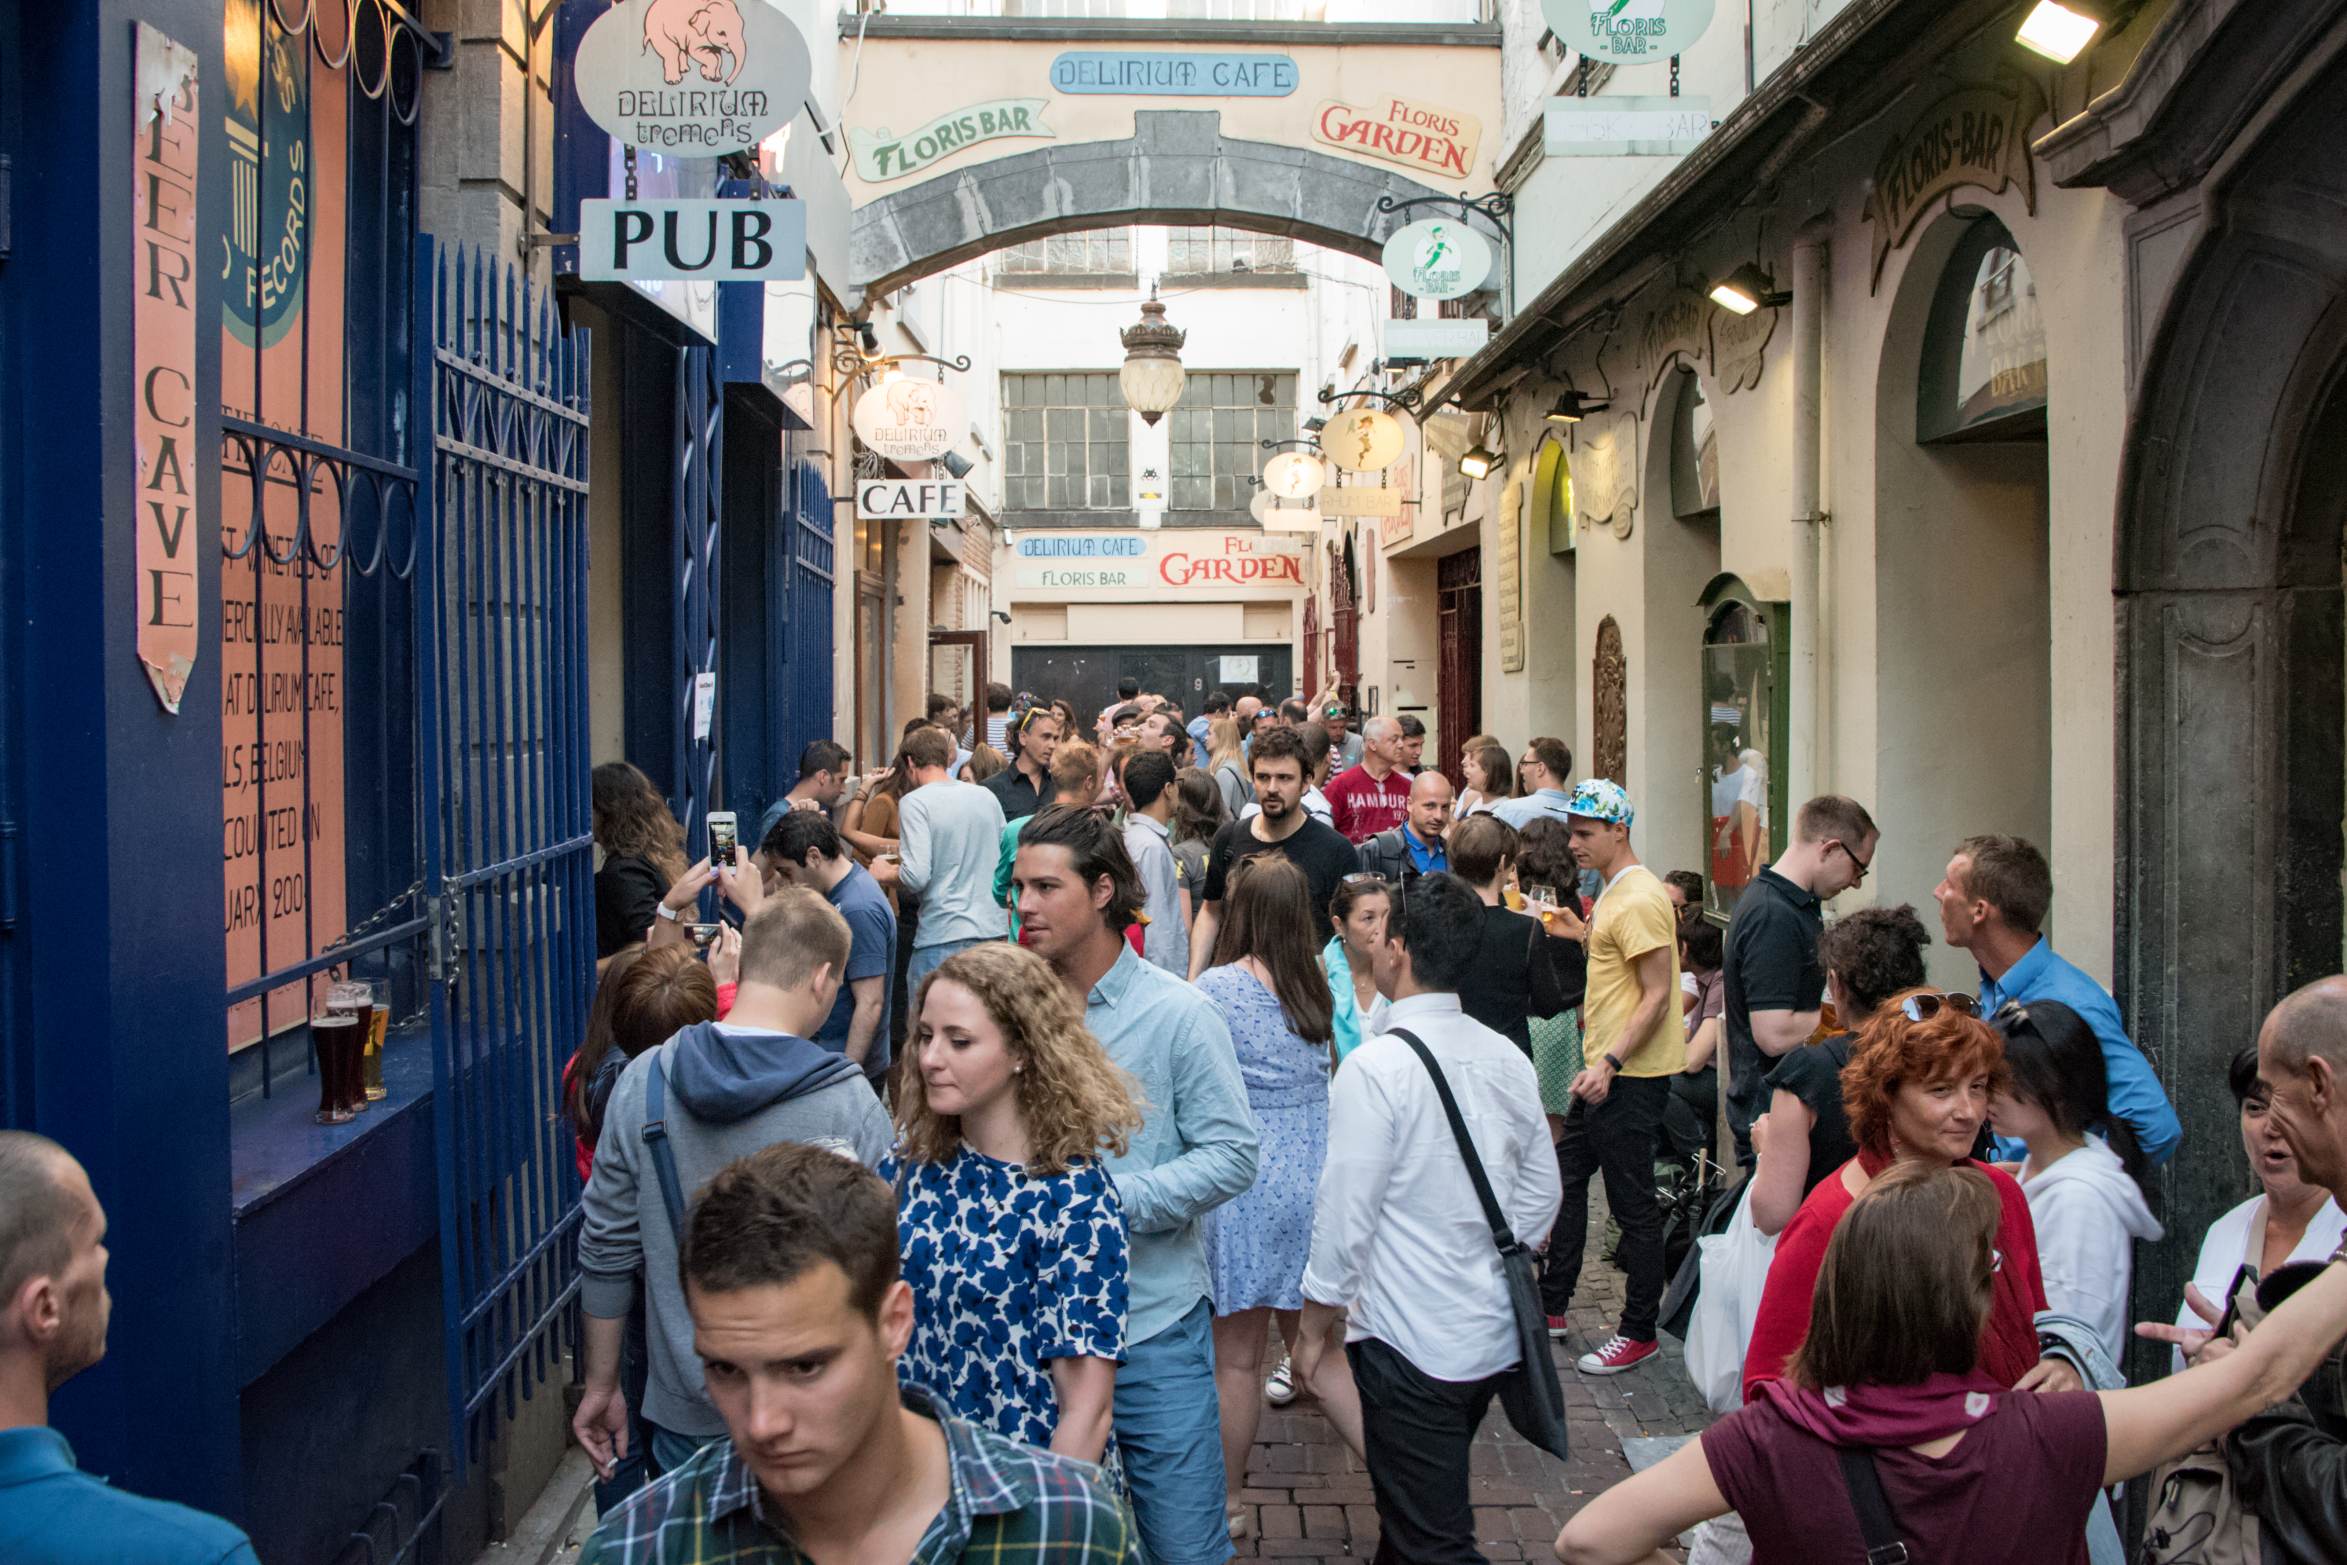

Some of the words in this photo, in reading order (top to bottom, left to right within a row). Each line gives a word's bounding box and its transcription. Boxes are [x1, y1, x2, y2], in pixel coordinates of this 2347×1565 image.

[1591, 12, 1667, 36] FLORIS
[1611, 37, 1647, 54] BAR
[1059, 60, 1197, 87] DELIRIUM
[1212, 61, 1292, 88] CAFE
[617, 90, 769, 118] DELIRIUM
[1387, 99, 1461, 137] FLORIS
[636, 117, 753, 147] tremens
[873, 115, 978, 177] FLORIS
[979, 106, 1033, 136] BAR
[1320, 105, 1470, 176] GARDEN
[143, 75, 196, 311] EER
[612, 209, 774, 272] PUB
[874, 427, 948, 442] DELIRIUM
[143, 365, 195, 628] CAVE
[862, 484, 957, 515] CAFE
[1024, 538, 1096, 556] DELIRIUM
[1102, 537, 1139, 556] CAFE
[1224, 536, 1253, 554] FL
[1042, 569, 1095, 586] FLORIS
[1099, 571, 1126, 586] BAR
[1159, 552, 1304, 586] GARDEN
[285, 603, 343, 647] AVALABLE
[224, 672, 243, 716] AT
[247, 672, 303, 715] DLIRIUM
[1346, 792, 1410, 809] HAMBUR
[223, 805, 298, 861] COUTED
[272, 872, 306, 920] 200
